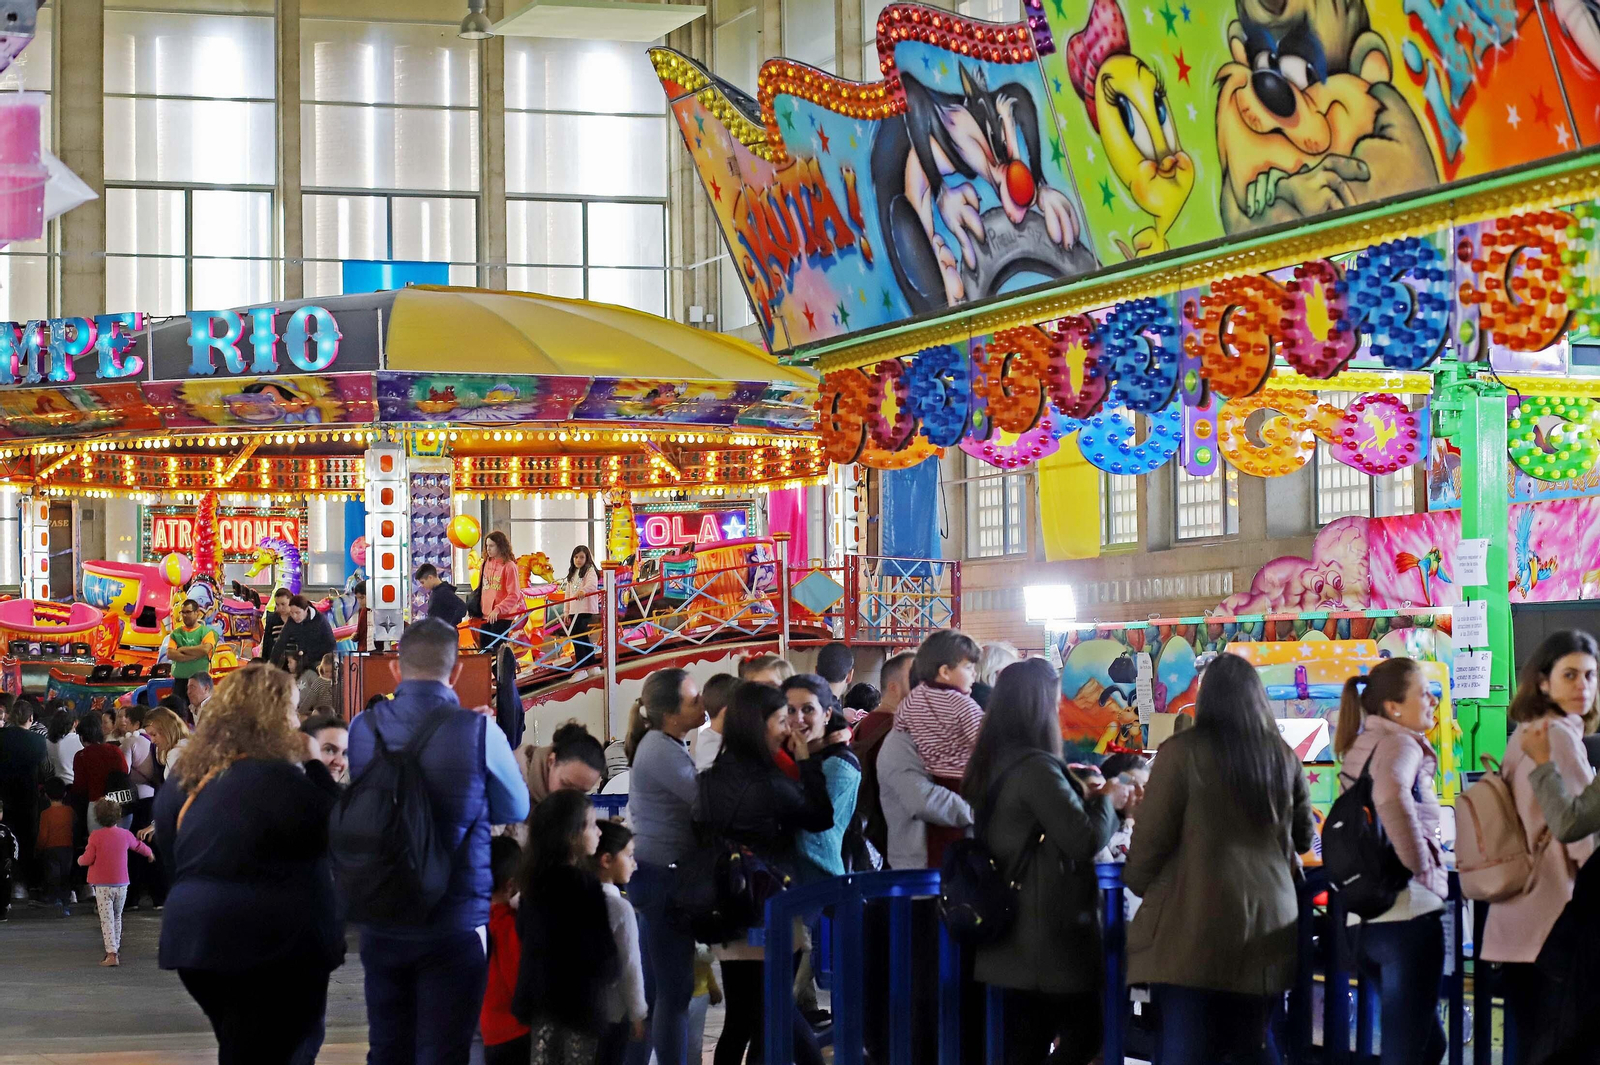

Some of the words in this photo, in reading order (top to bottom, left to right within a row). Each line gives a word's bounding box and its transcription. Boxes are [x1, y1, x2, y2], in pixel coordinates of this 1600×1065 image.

[186, 305, 343, 375] RIO
[155, 519, 295, 549] ATRCIONES
[645, 514, 722, 547] OLA
